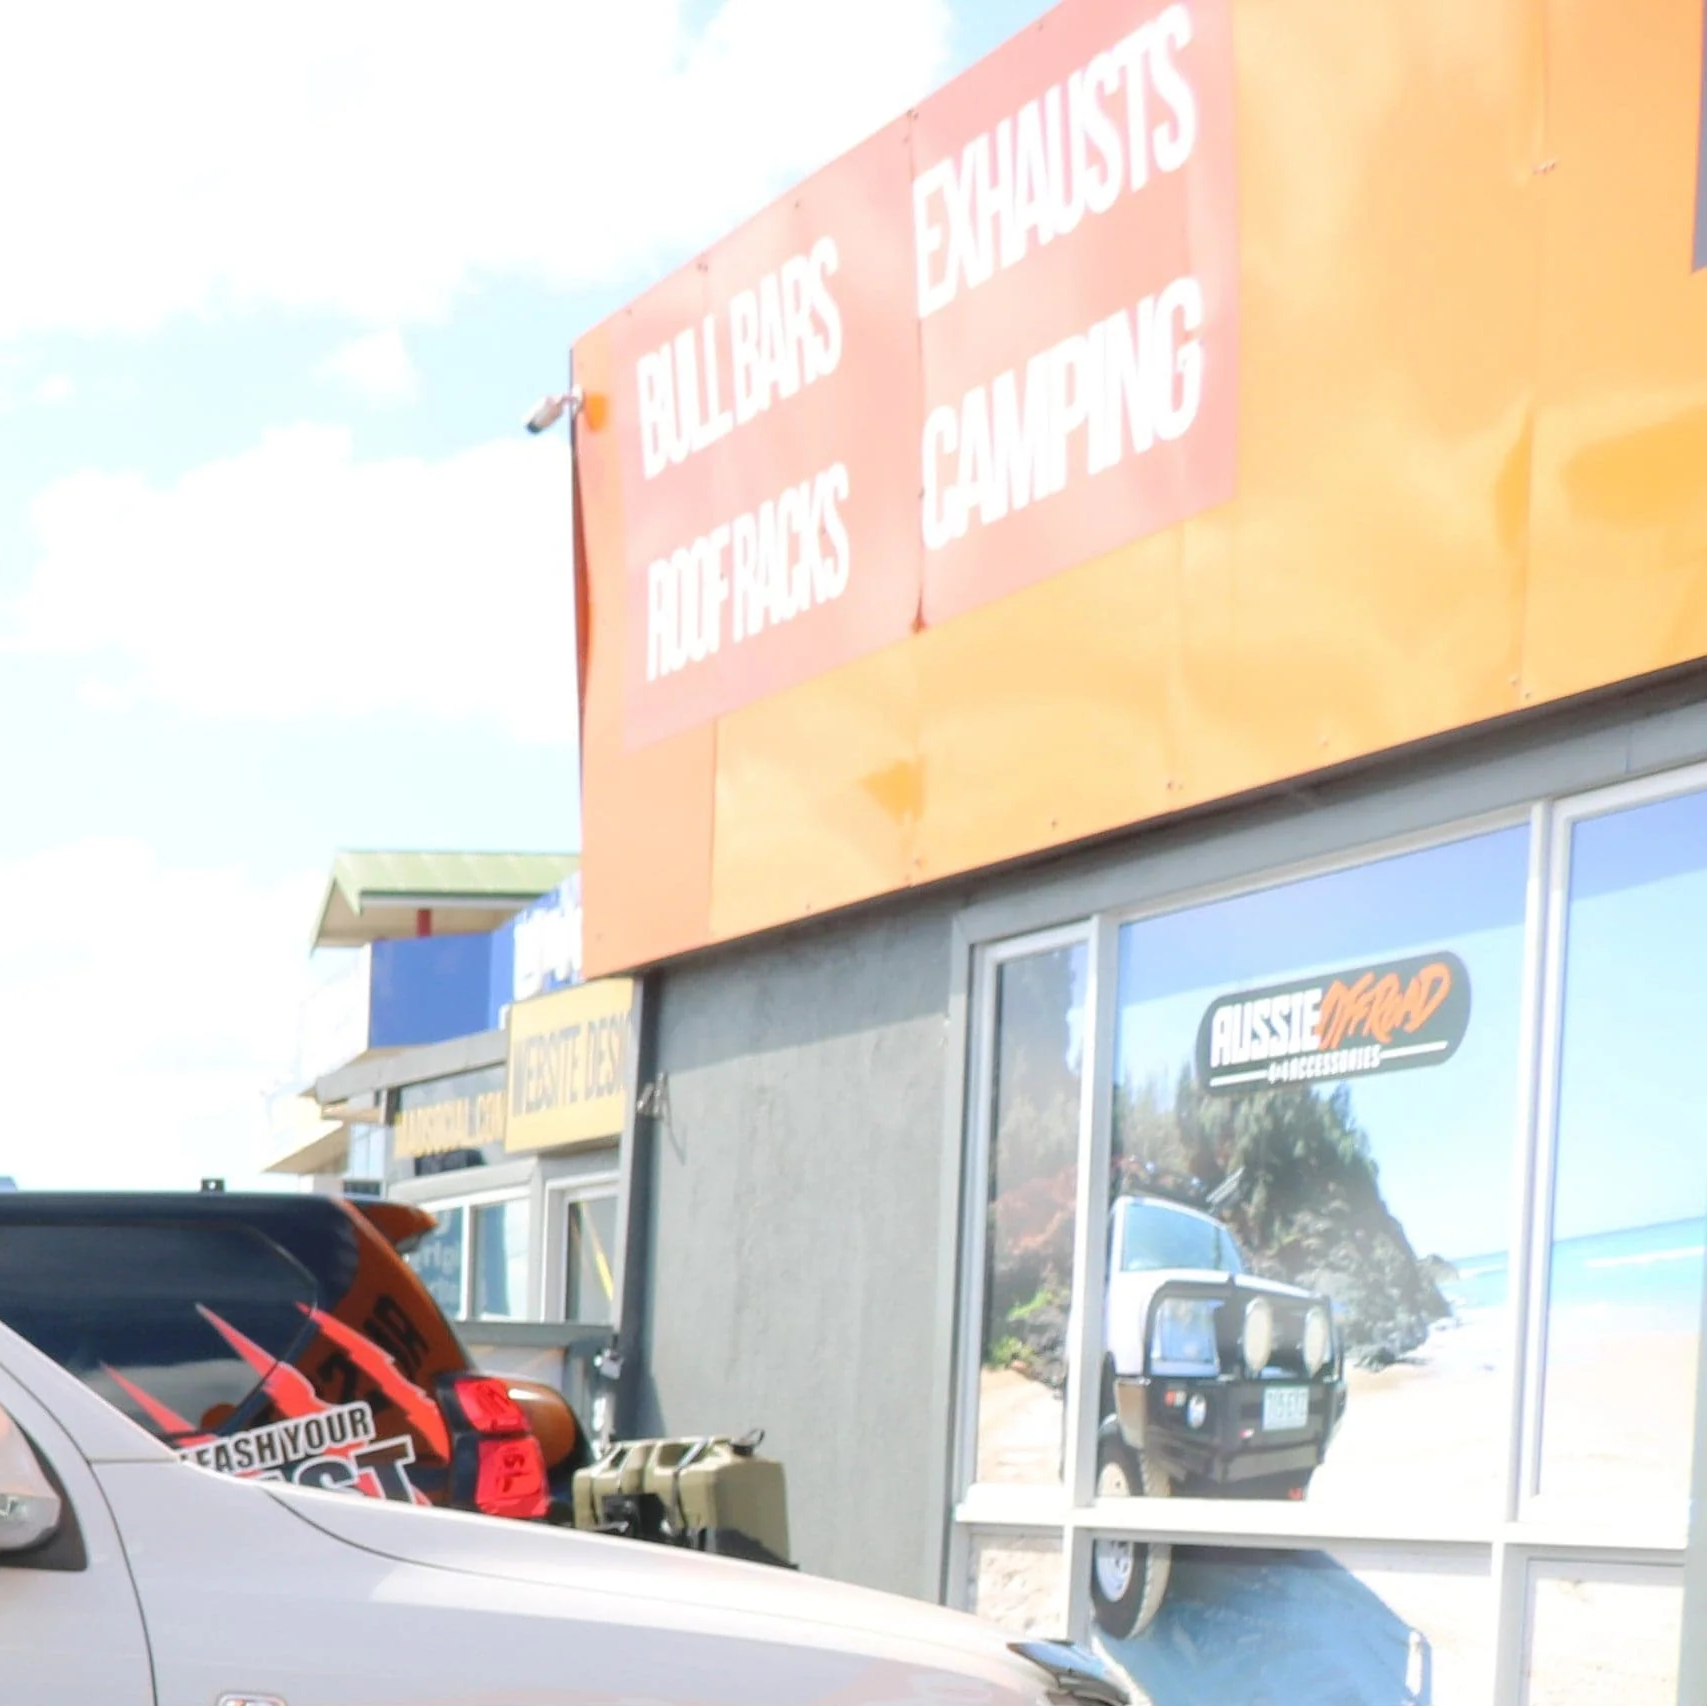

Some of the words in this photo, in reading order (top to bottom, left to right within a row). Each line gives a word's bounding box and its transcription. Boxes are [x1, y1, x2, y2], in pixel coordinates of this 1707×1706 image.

[912, 2, 1198, 318] EXHAUSTS
[637, 314, 734, 480] BULL
[730, 236, 842, 426] BARS
[921, 276, 1204, 551] CAMPING
[646, 522, 730, 683] ROOF
[732, 462, 850, 644] RACKS
[512, 1023, 581, 1117] WEBSITE
[1210, 988, 1323, 1068] AUSSIE
[1289, 1044, 1382, 1082] ACCESSORIES
[180, 1432, 281, 1474] EASH
[282, 1407, 370, 1452] YOUR
